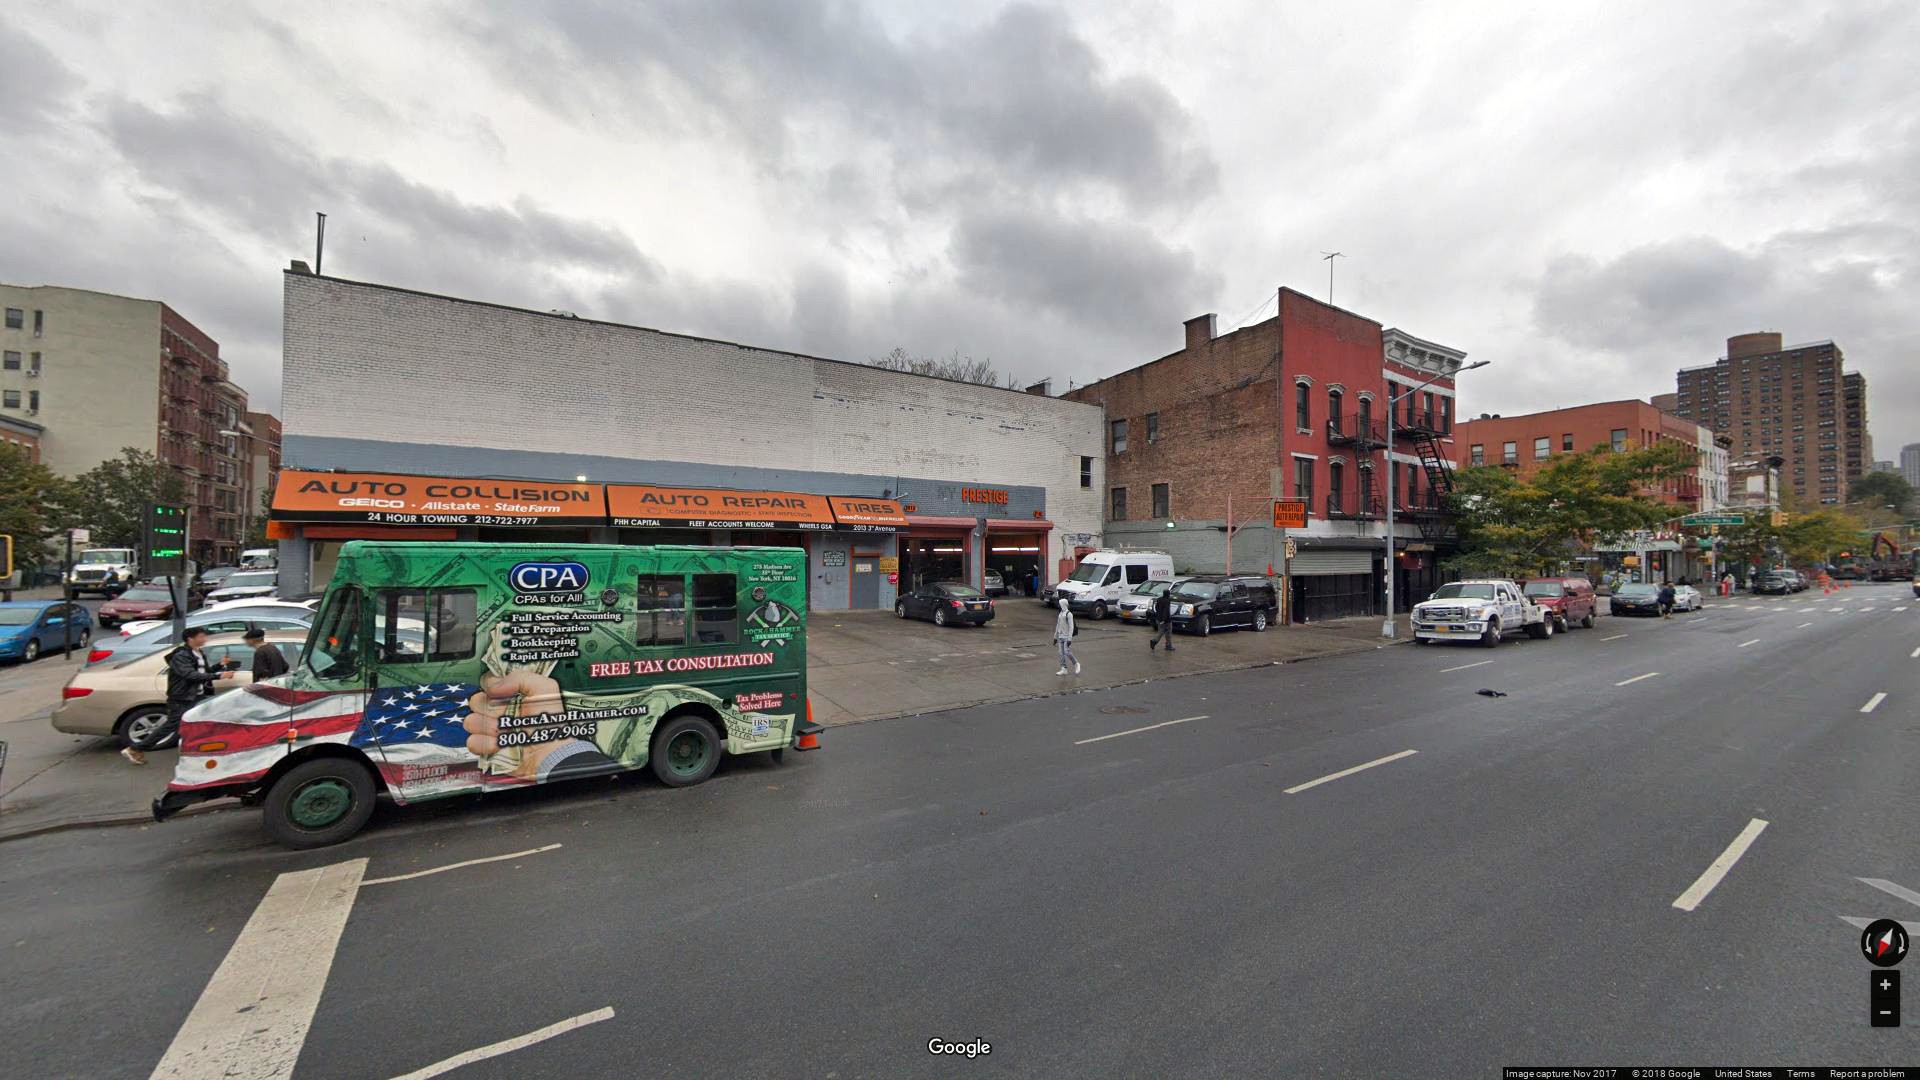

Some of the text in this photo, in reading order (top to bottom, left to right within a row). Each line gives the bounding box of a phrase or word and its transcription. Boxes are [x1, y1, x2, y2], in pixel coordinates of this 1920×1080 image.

[298, 480, 590, 502] AUTO COLLISION
[962, 487, 1009, 505] PRESTIGE
[338, 497, 405, 509] GEICO
[420, 501, 481, 511] Allstate
[640, 493, 807, 509] AUTO REPAIR
[841, 502, 895, 514] TIRES
[367, 512, 538, 525] 24 HOUR TOWING 212-722-7977
[614, 518, 661, 527] PHH CAPITAL
[517, 566, 580, 589] CPA
[515, 593, 583, 605] CPAs for All!
[512, 611, 622, 623] Full Service Accounting
[511, 624, 590, 636] Tax Preparation
[511, 637, 577, 648] Bookkeeping
[510, 649, 579, 663] Rapid Refunds
[591, 652, 774, 677] FREE TAX CONSULTATION
[750, 692, 783, 701] Problems
[740, 700, 782, 711] Solved Here
[752, 719, 768, 727] IRS
[499, 723, 596, 746] 800.487.9065
